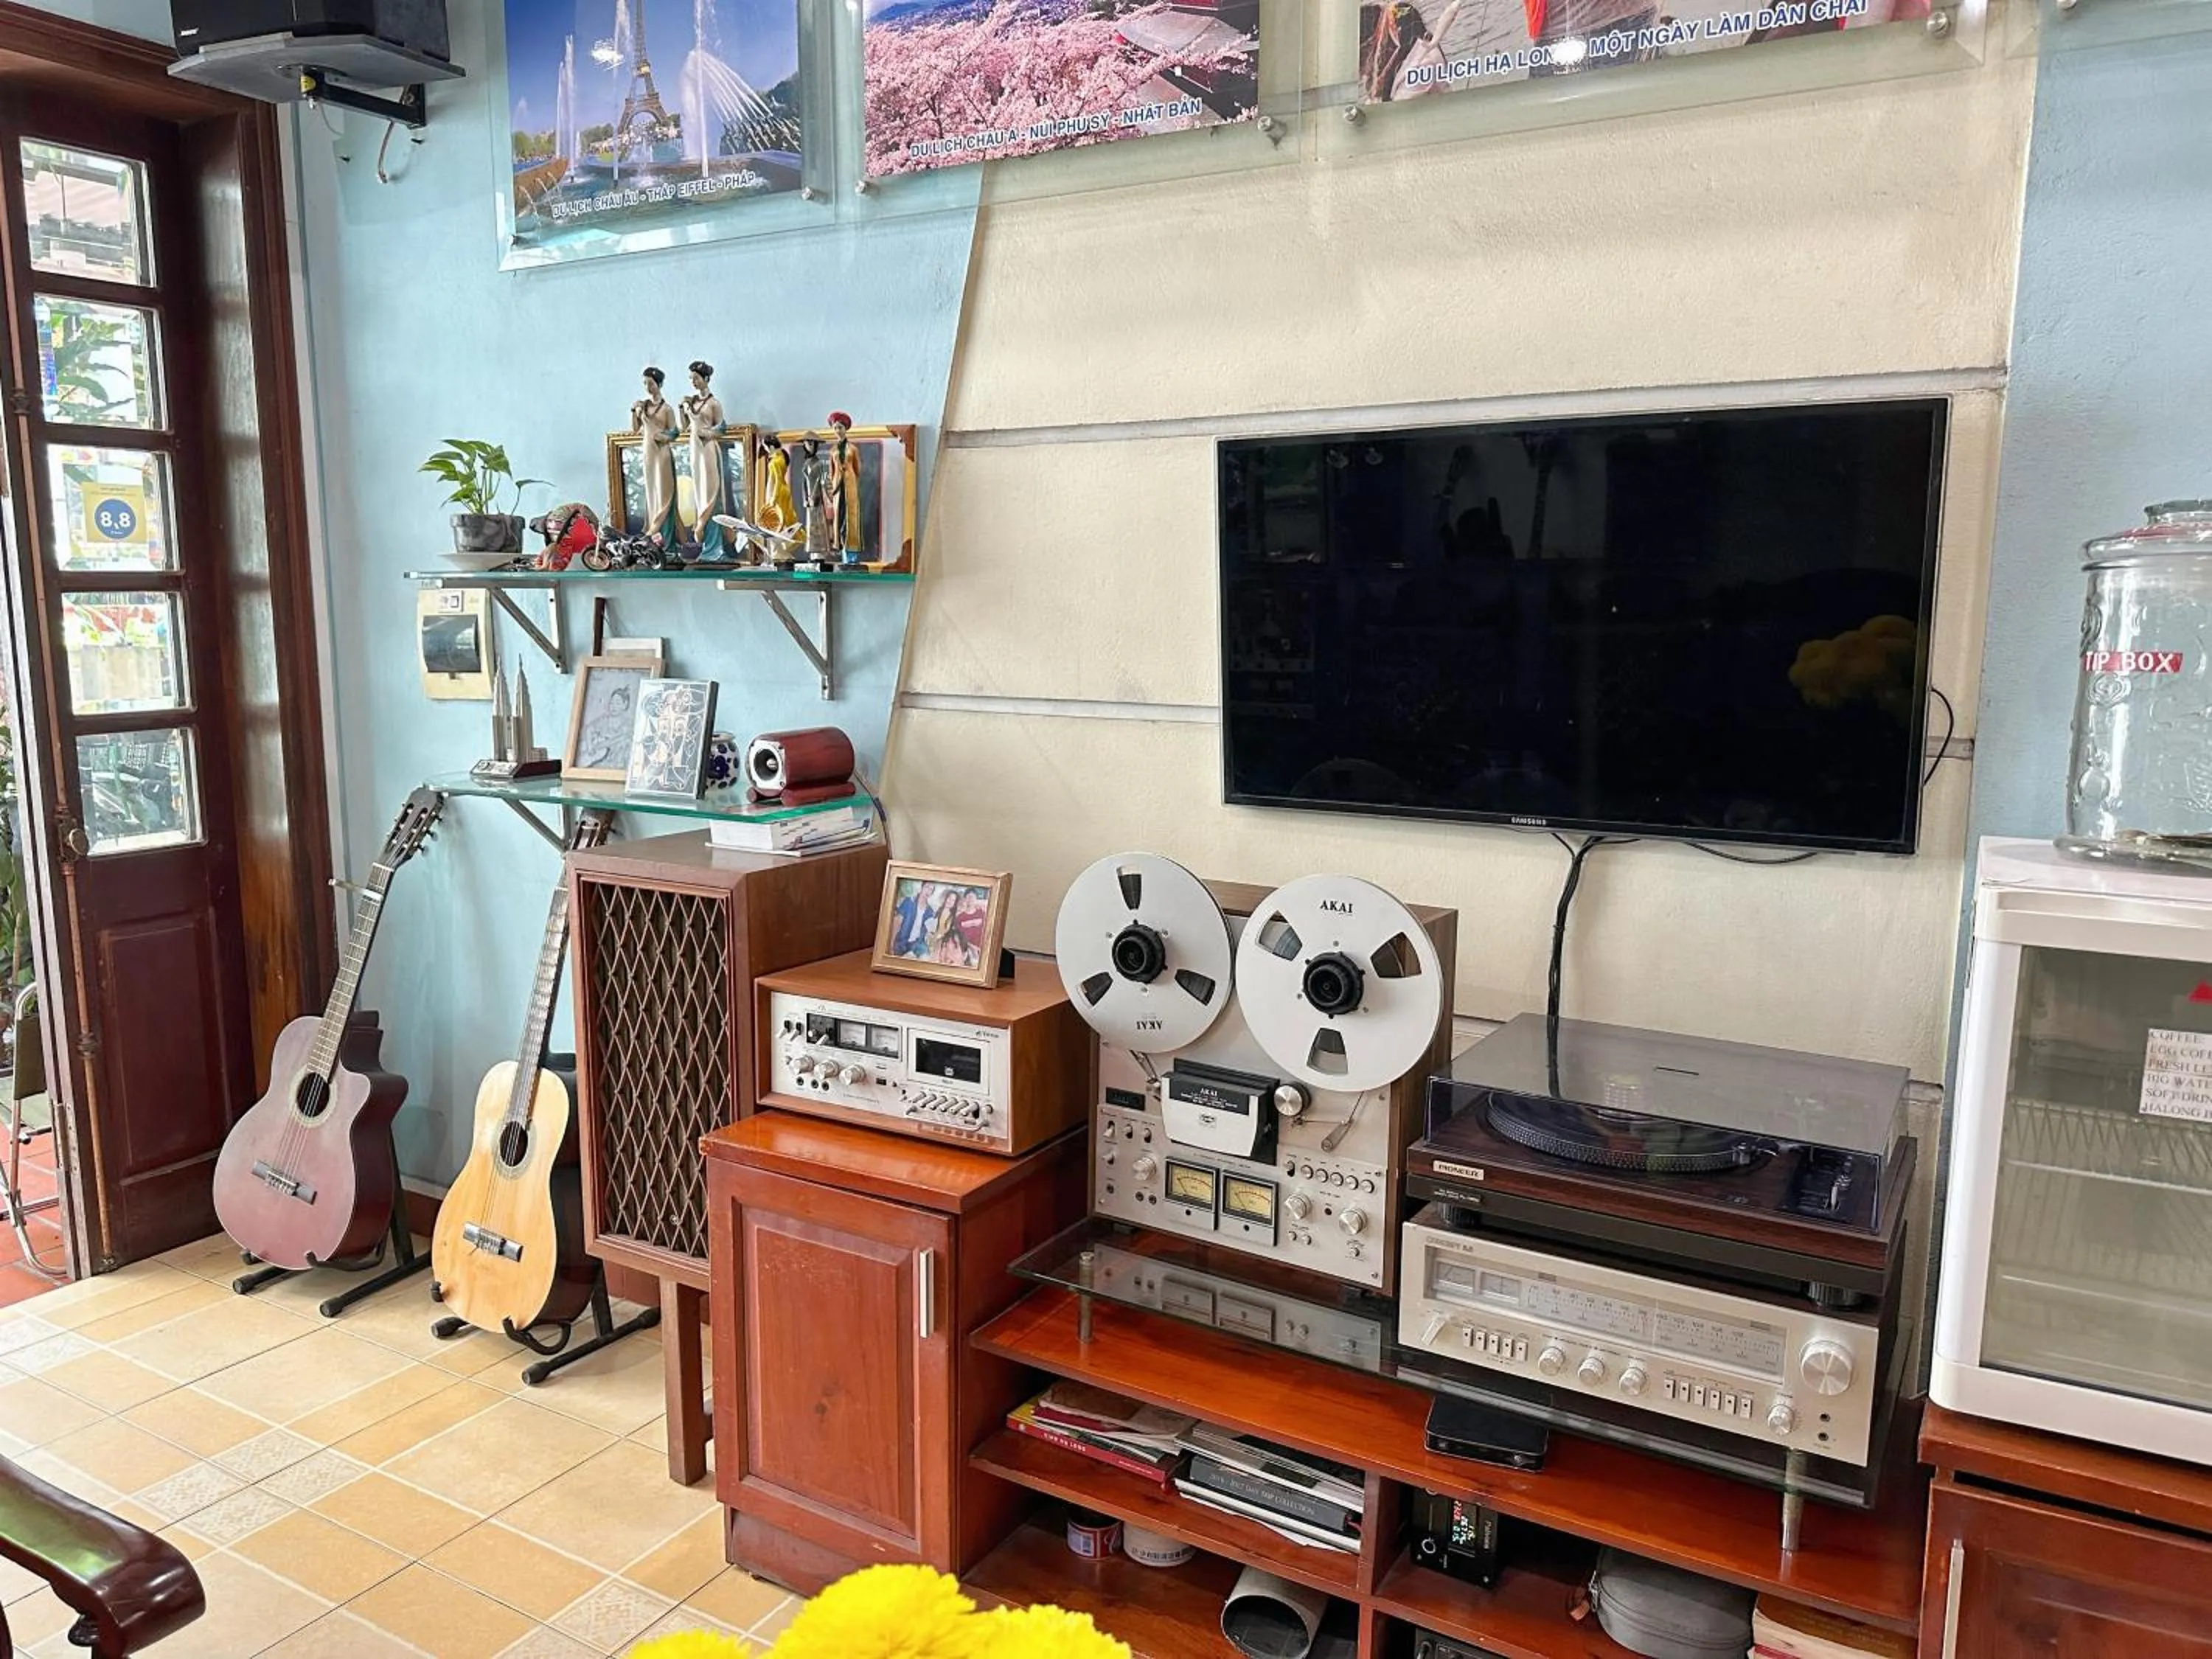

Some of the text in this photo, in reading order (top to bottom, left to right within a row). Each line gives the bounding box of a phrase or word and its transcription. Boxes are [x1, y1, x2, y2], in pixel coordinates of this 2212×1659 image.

[1407, 66, 1432, 86] DU
[1437, 58, 1480, 82] LỊCH
[1485, 54, 1512, 75] HẠ
[1517, 44, 1559, 68] LON
[1589, 29, 1635, 58] MỘT
[1638, 21, 1700, 48] NGÀY
[1705, 13, 1750, 38] LÀM
[1758, 3, 1806, 29] DÂN
[910, 143, 929, 159] DU
[1122, 102, 1164, 125] NHẬT
[1168, 94, 1203, 118] BẢN
[677, 178, 716, 198] EIFFEL
[2085, 651, 2175, 673] TIP BOX
[1319, 899, 1354, 914] AKAI
[1136, 1020, 1163, 1030] AKAI
[2149, 1058, 2190, 1072] FRESH
[2146, 1073, 2170, 1085] BIG
